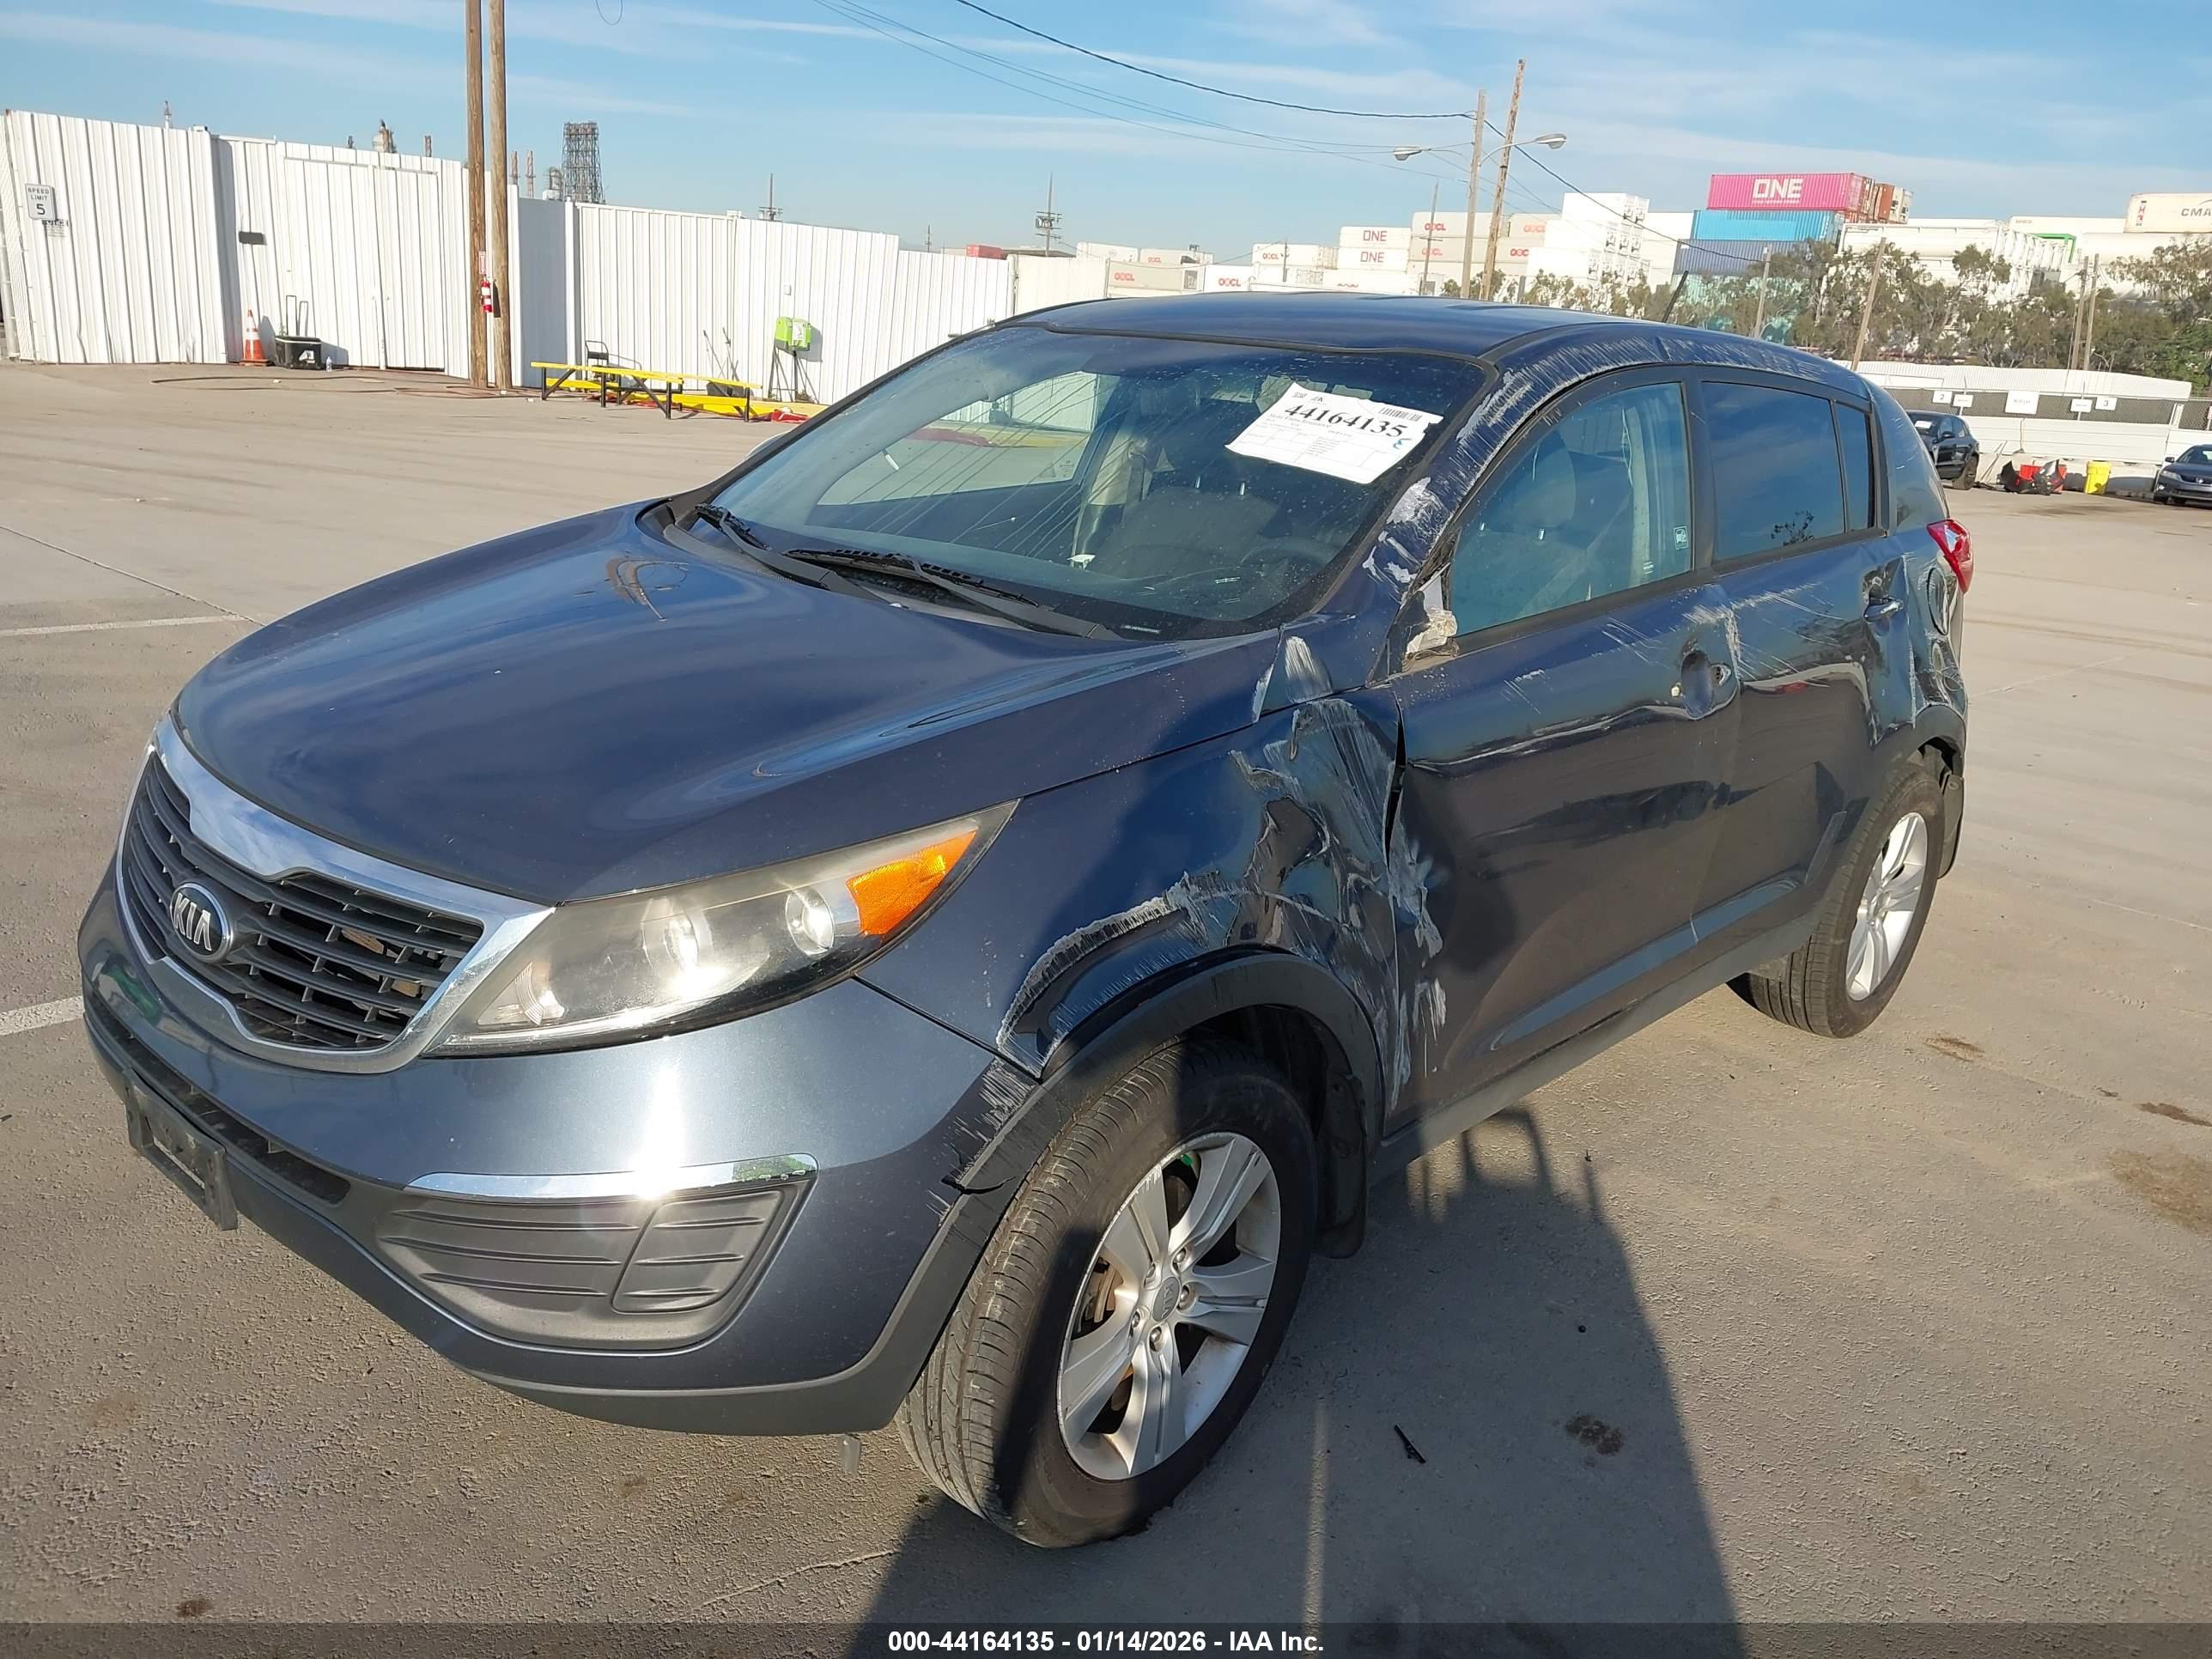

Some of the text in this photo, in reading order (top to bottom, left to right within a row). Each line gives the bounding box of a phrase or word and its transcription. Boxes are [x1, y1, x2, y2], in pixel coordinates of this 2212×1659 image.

[1752, 178, 1803, 198] ONE
[36, 203, 46, 216] 5
[2180, 208, 2211, 216] CMA
[1363, 230, 1388, 242] ONE
[1360, 252, 1384, 263] ONE
[1510, 248, 1529, 257] OOC
[1115, 272, 1135, 282] OOCL
[1218, 278, 1242, 287] OOCL
[1285, 404, 1408, 437] 44164135
[173, 891, 212, 951] KIA
